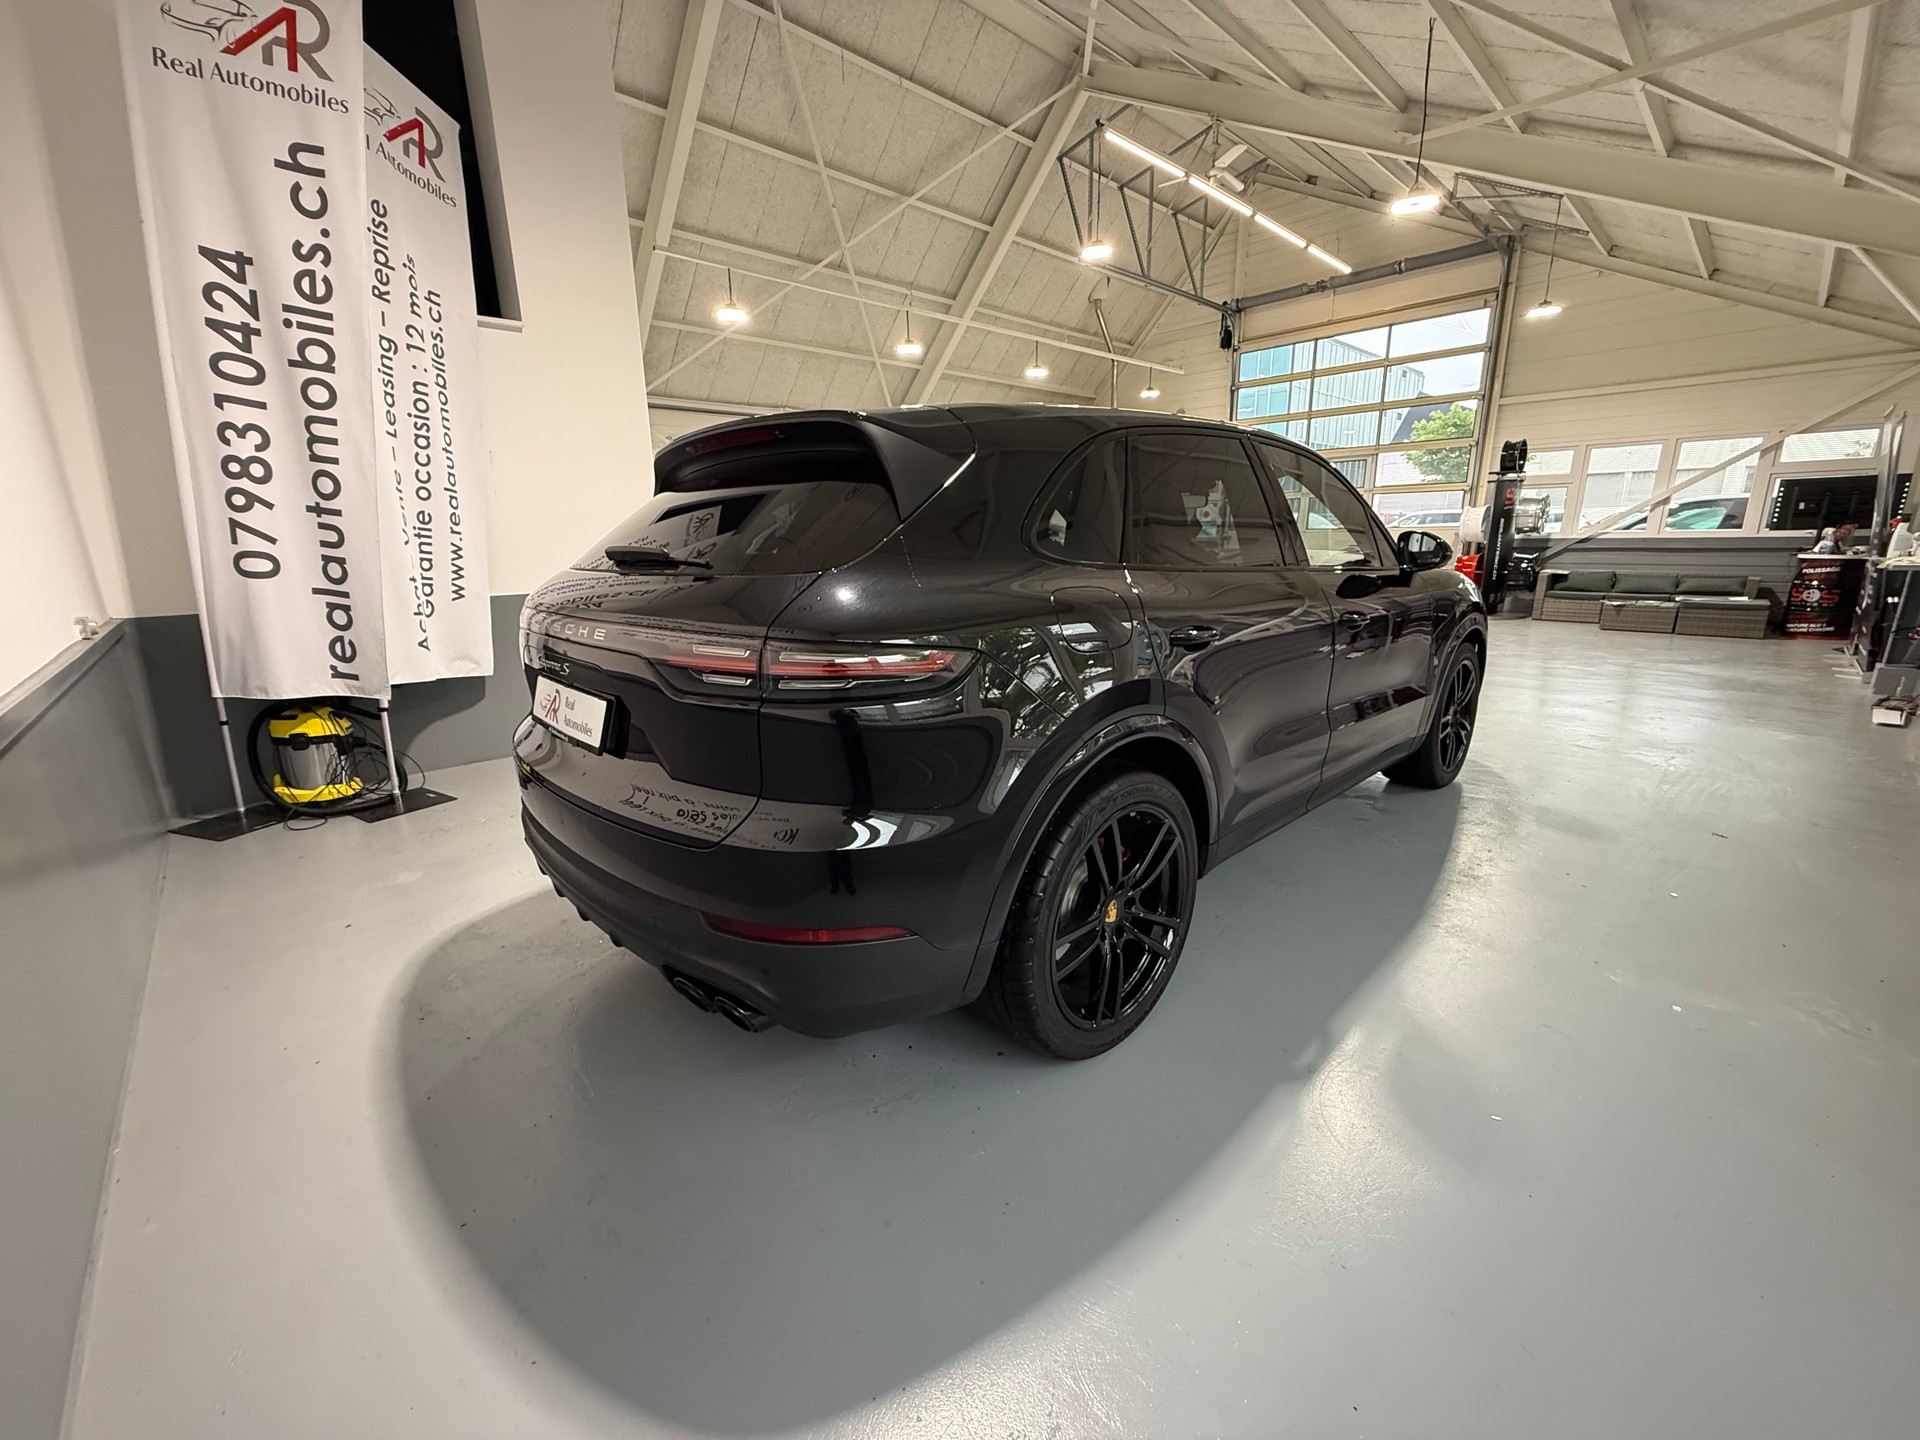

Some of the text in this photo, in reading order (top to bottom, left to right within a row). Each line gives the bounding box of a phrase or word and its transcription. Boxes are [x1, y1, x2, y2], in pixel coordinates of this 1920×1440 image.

[152, 47, 350, 114] Real Automobiles
[376, 142, 457, 208] Automobiles
[367, 199, 396, 304] Reprise
[402, 254, 422, 319] mois
[405, 325, 426, 353] 12
[198, 245, 281, 580] 0798310424
[274, 142, 360, 681] realautomobiles.ch
[377, 334, 398, 439] Leasing
[407, 381, 432, 501] occasion
[424, 290, 466, 601] www.realautomobiles.ch
[413, 511, 435, 618] Garantie
[553, 621, 606, 640] SCHE
[564, 696, 576, 711] Real
[564, 714, 593, 738] Automobiles
